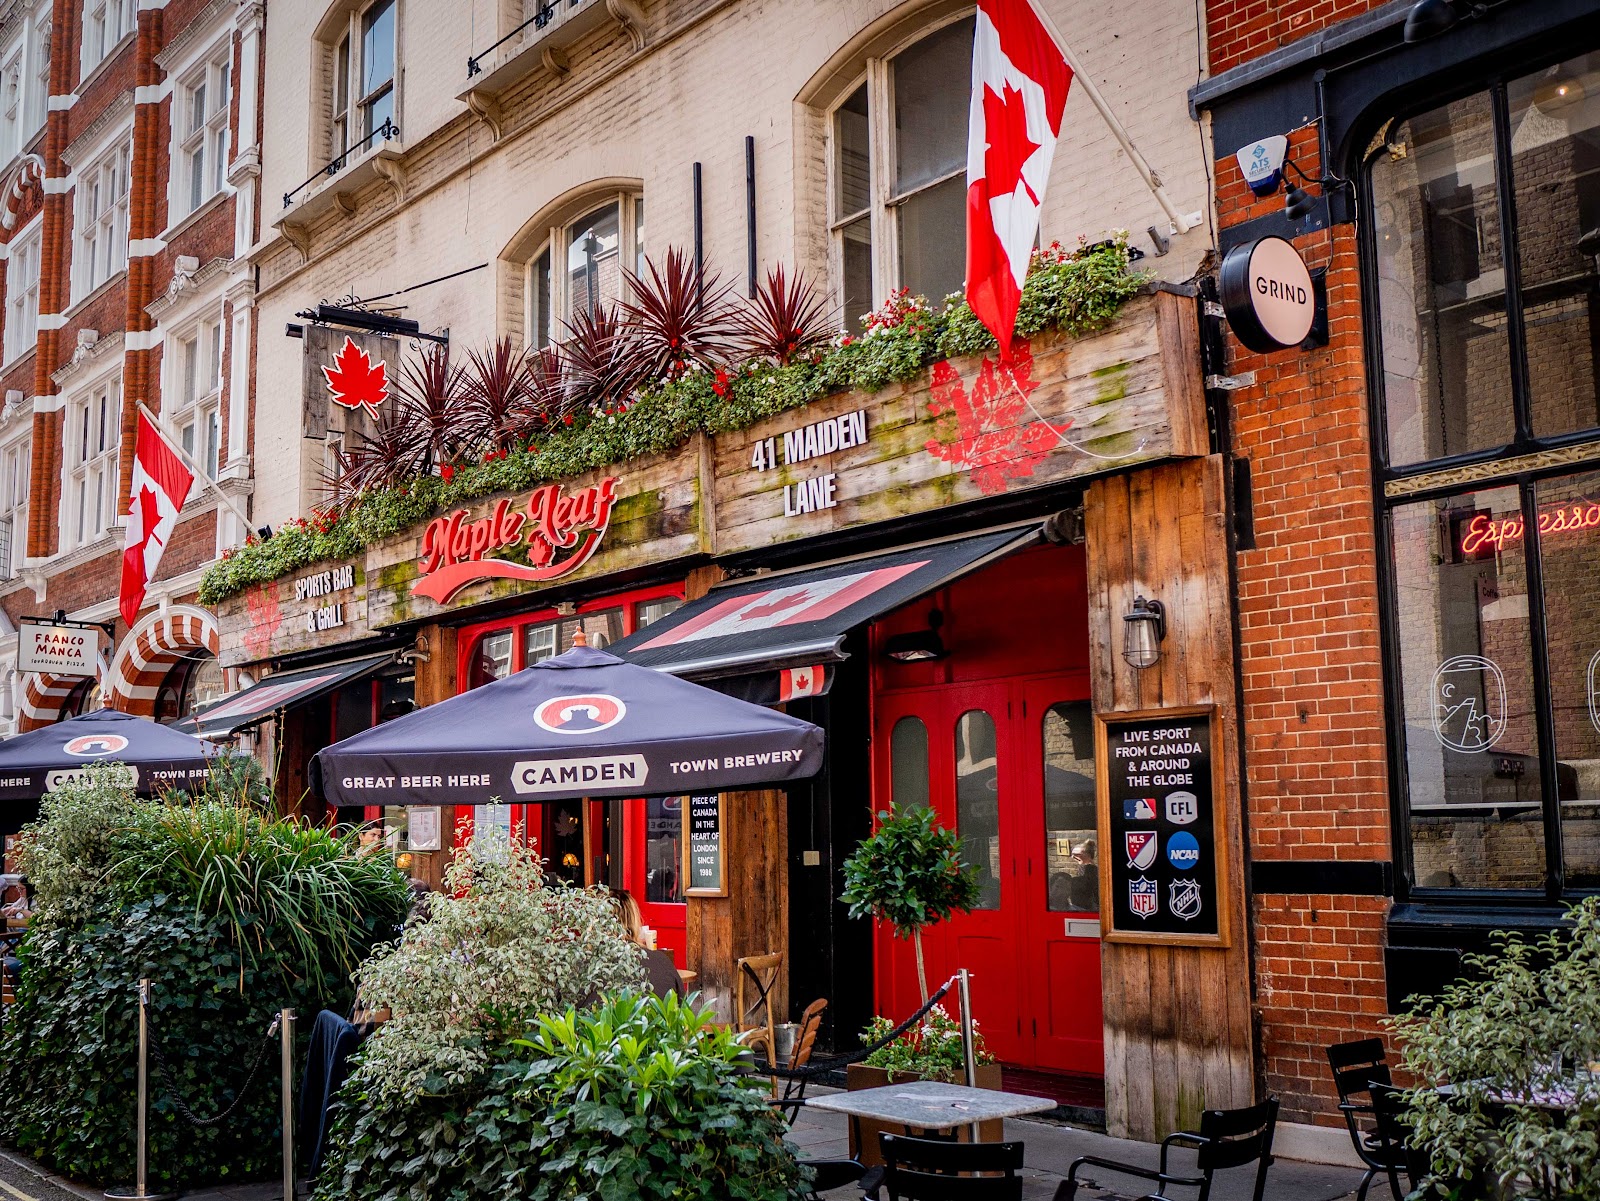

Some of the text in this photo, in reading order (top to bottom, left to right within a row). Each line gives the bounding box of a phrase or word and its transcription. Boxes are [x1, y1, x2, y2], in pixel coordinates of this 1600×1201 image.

[1249, 165, 1270, 175] SECURITY
[1251, 157, 1269, 171] ATS
[1256, 276, 1307, 305] GRIND
[752, 409, 868, 472] 41 MAIDEN
[784, 473, 838, 518] LANE
[418, 477, 623, 574] Maple Leaf
[1462, 506, 1600, 552] Espesso
[295, 565, 354, 601] SPORTS BAR
[307, 604, 344, 632] & GRILL
[35, 633, 84, 645] FRANCO
[35, 644, 82, 657] MANCA
[1124, 727, 1192, 743] LIVE SPORT
[1115, 742, 1202, 758] FROM CANADA
[342, 749, 803, 789] GREAT BEER HERE CAMDEN TOWN BREWERY
[1128, 758, 1190, 772] & AROUND
[0, 778, 30, 787] HERE
[153, 771, 185, 779] TOWN
[1127, 773, 1193, 787] THE GLOBE
[692, 796, 717, 805] PIECE OF
[692, 808, 717, 817] CANADA
[1171, 802, 1192, 815] CFL
[695, 820, 714, 829] IN THE
[691, 832, 719, 841] HEART OF
[1129, 835, 1144, 844] MLS
[693, 844, 718, 853] LONDON
[1170, 849, 1199, 860] NCAA
[697, 856, 714, 864] SINCE
[700, 868, 713, 876] 1986
[1132, 894, 1155, 911] NFL
[1176, 889, 1196, 911] NHL
